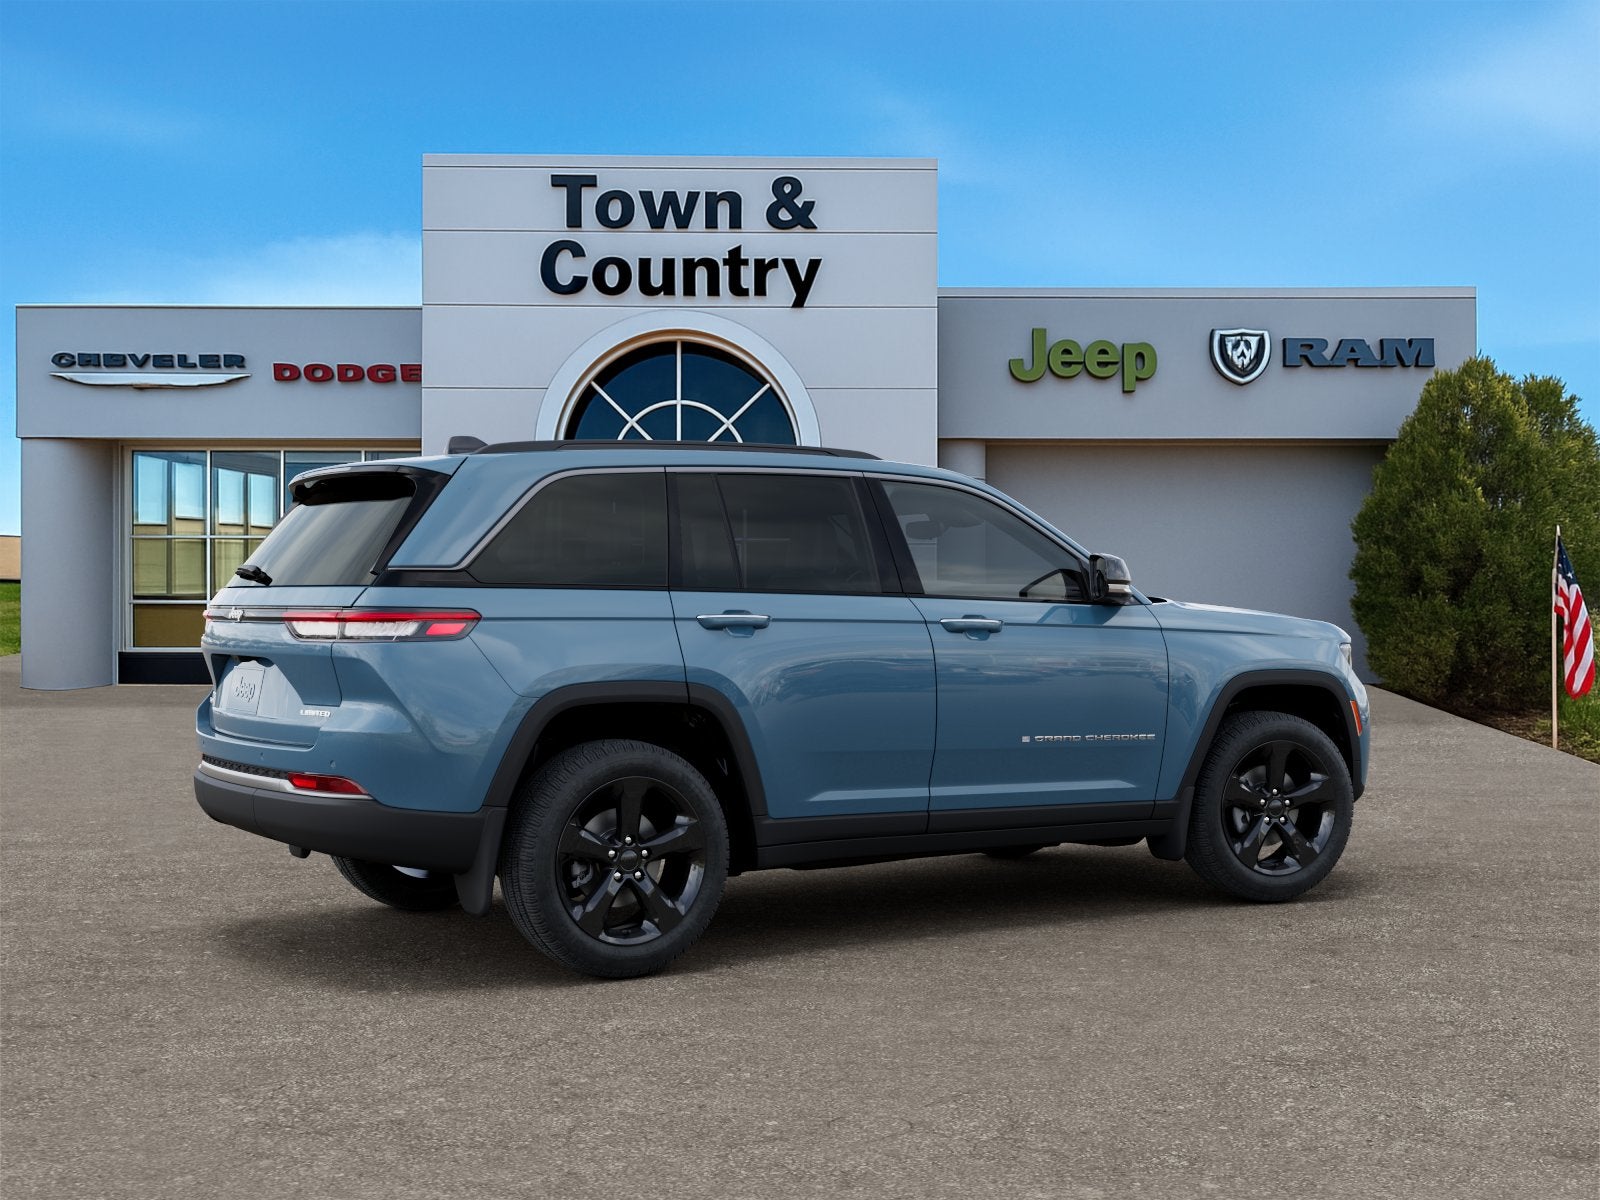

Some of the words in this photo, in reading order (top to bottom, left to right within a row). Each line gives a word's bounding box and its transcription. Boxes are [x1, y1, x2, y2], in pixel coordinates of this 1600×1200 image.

[550, 174, 742, 229] Town
[766, 176, 818, 229] &
[540, 239, 822, 308] Country
[273, 363, 422, 383] DODGE
[1009, 328, 1158, 393] Jeep
[1282, 338, 1435, 367] RAM
[1085, 733, 1156, 741] CHEROKEE
